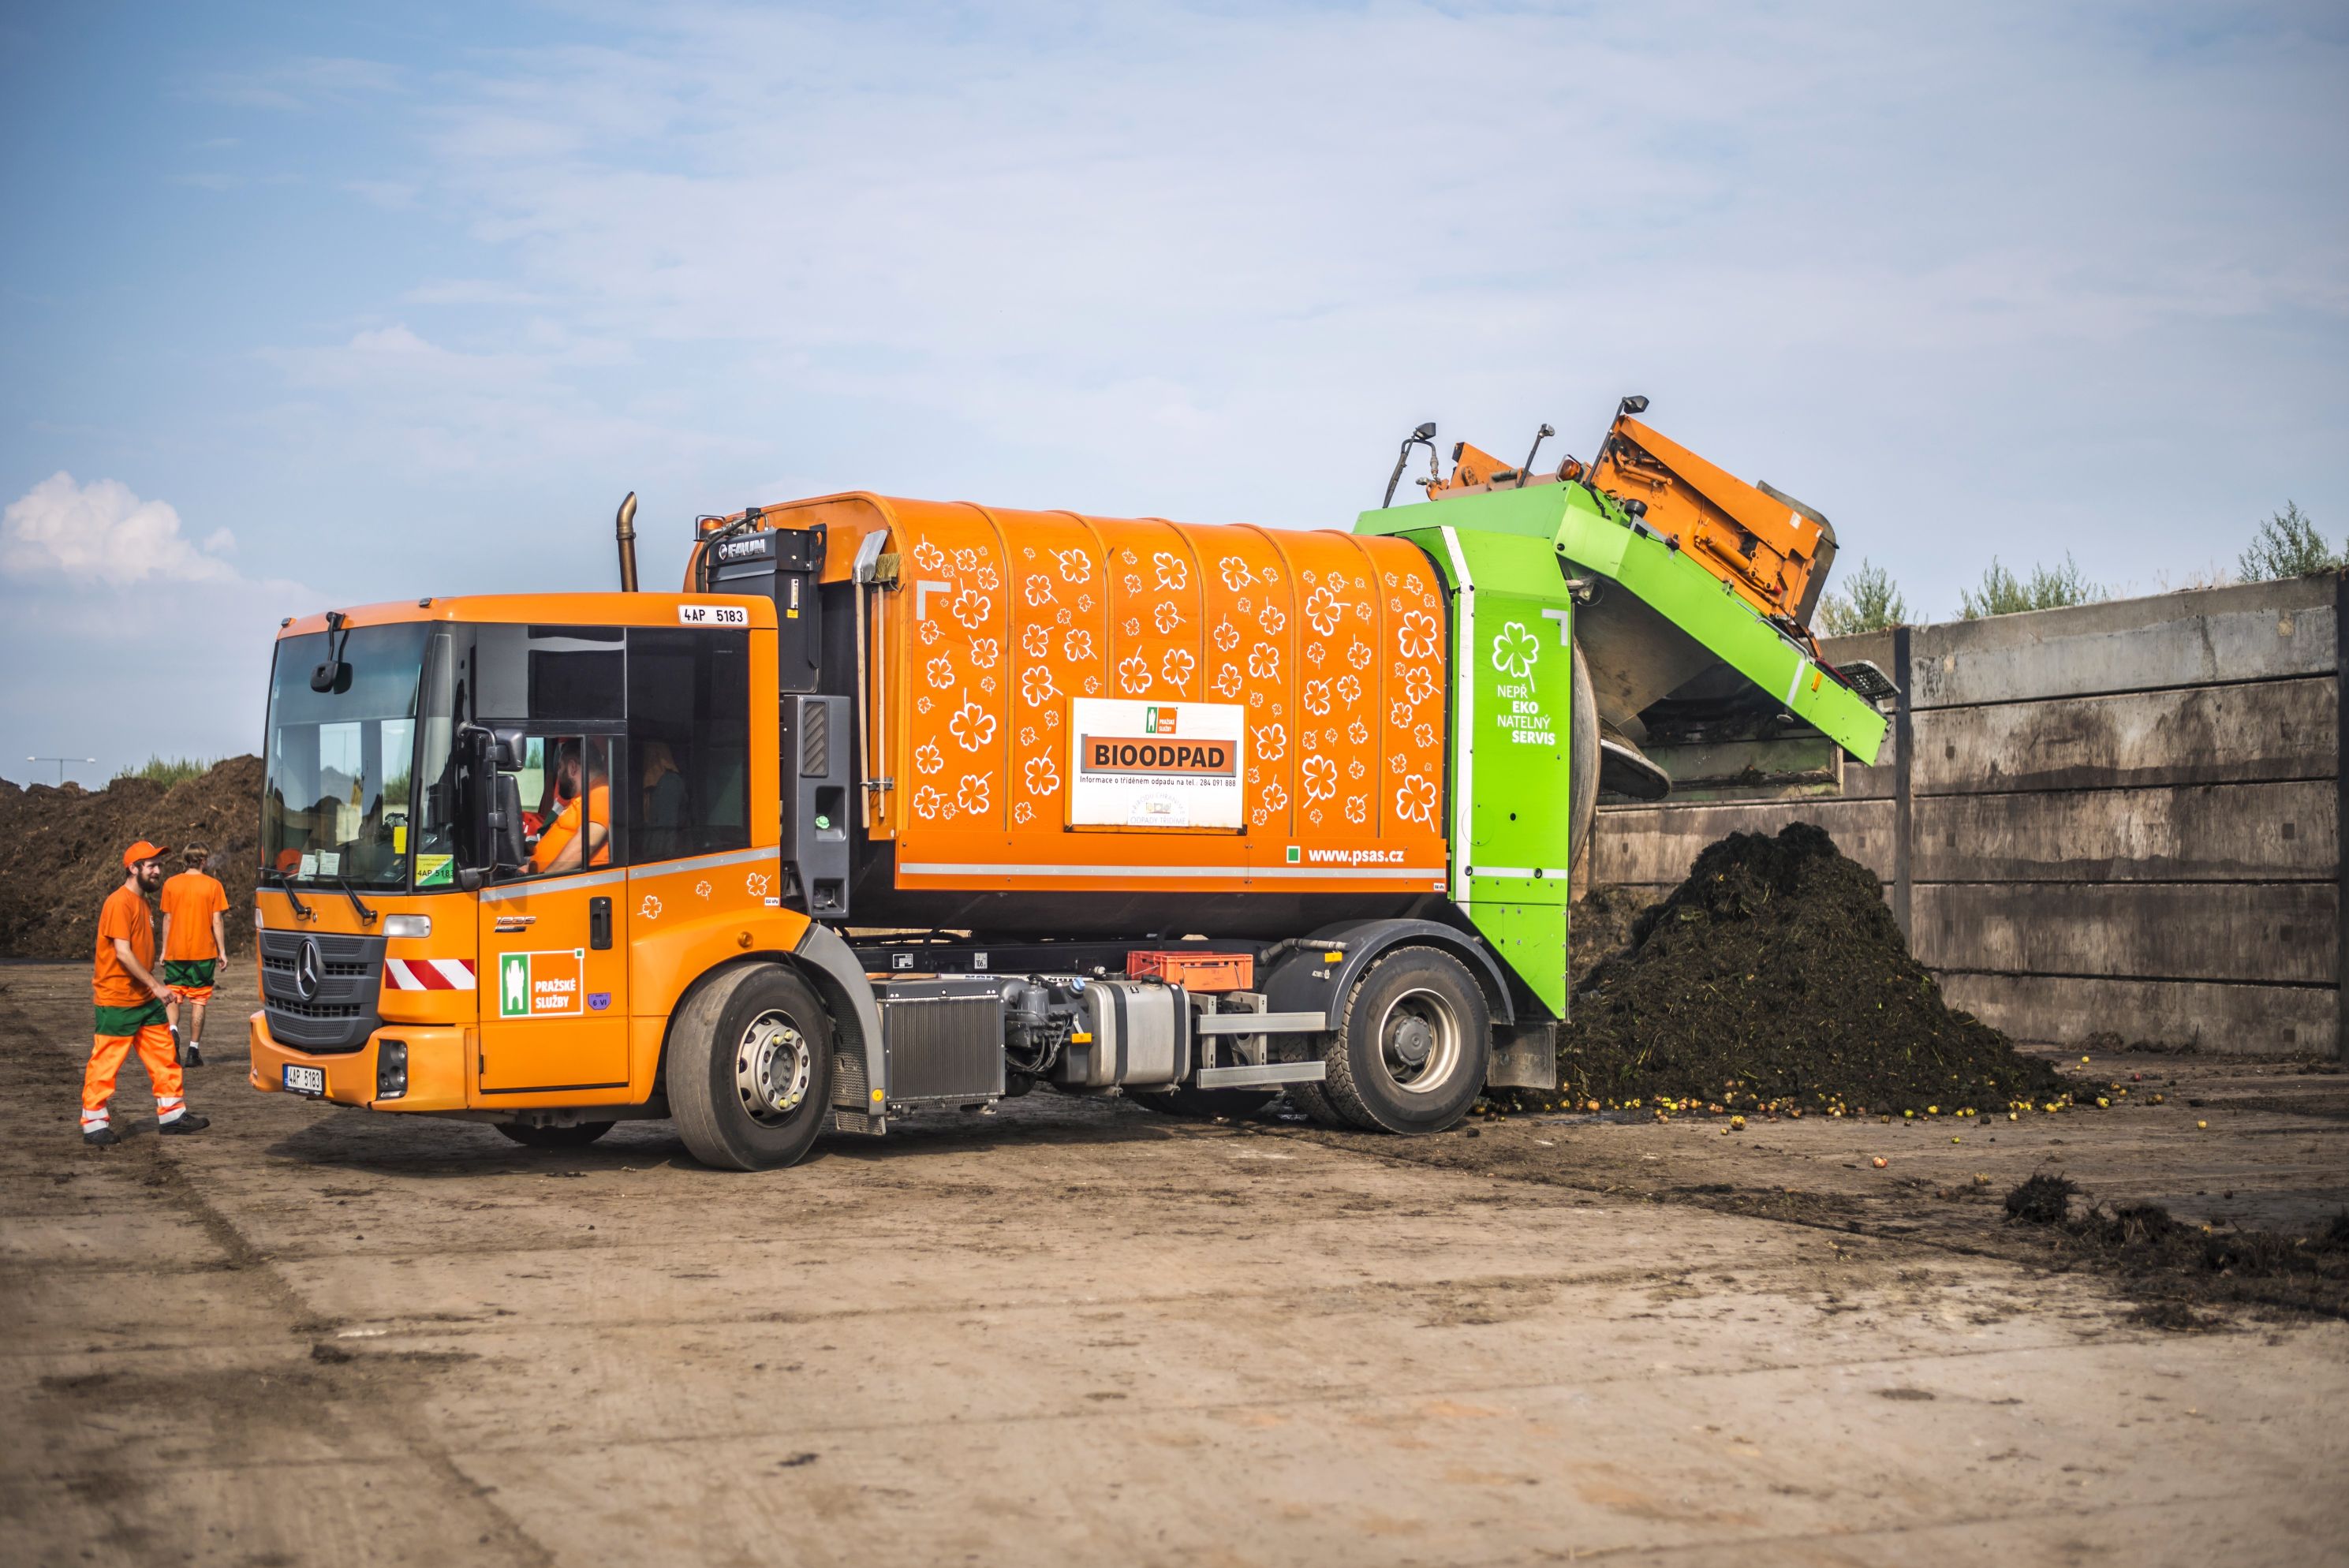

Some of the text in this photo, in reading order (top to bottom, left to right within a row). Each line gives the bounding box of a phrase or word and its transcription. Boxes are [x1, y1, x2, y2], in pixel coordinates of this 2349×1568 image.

[728, 539, 765, 558] FAUN
[685, 609, 743, 622] 4AP 5183
[1497, 683, 1529, 699] NEPŘ
[1512, 700, 1539, 714] EKO
[1497, 714, 1551, 730] NATELNÝ
[1512, 730, 1555, 745] SERVIS
[1095, 744, 1225, 768] BIOODPAD
[1152, 778, 1174, 786] odpadu
[1309, 849, 1404, 866] www.psas.cz
[535, 977, 577, 993] PRAŽSKÉ
[536, 994, 570, 1009] SLUŽBY
[289, 1068, 320, 1088] 4AP 5183
